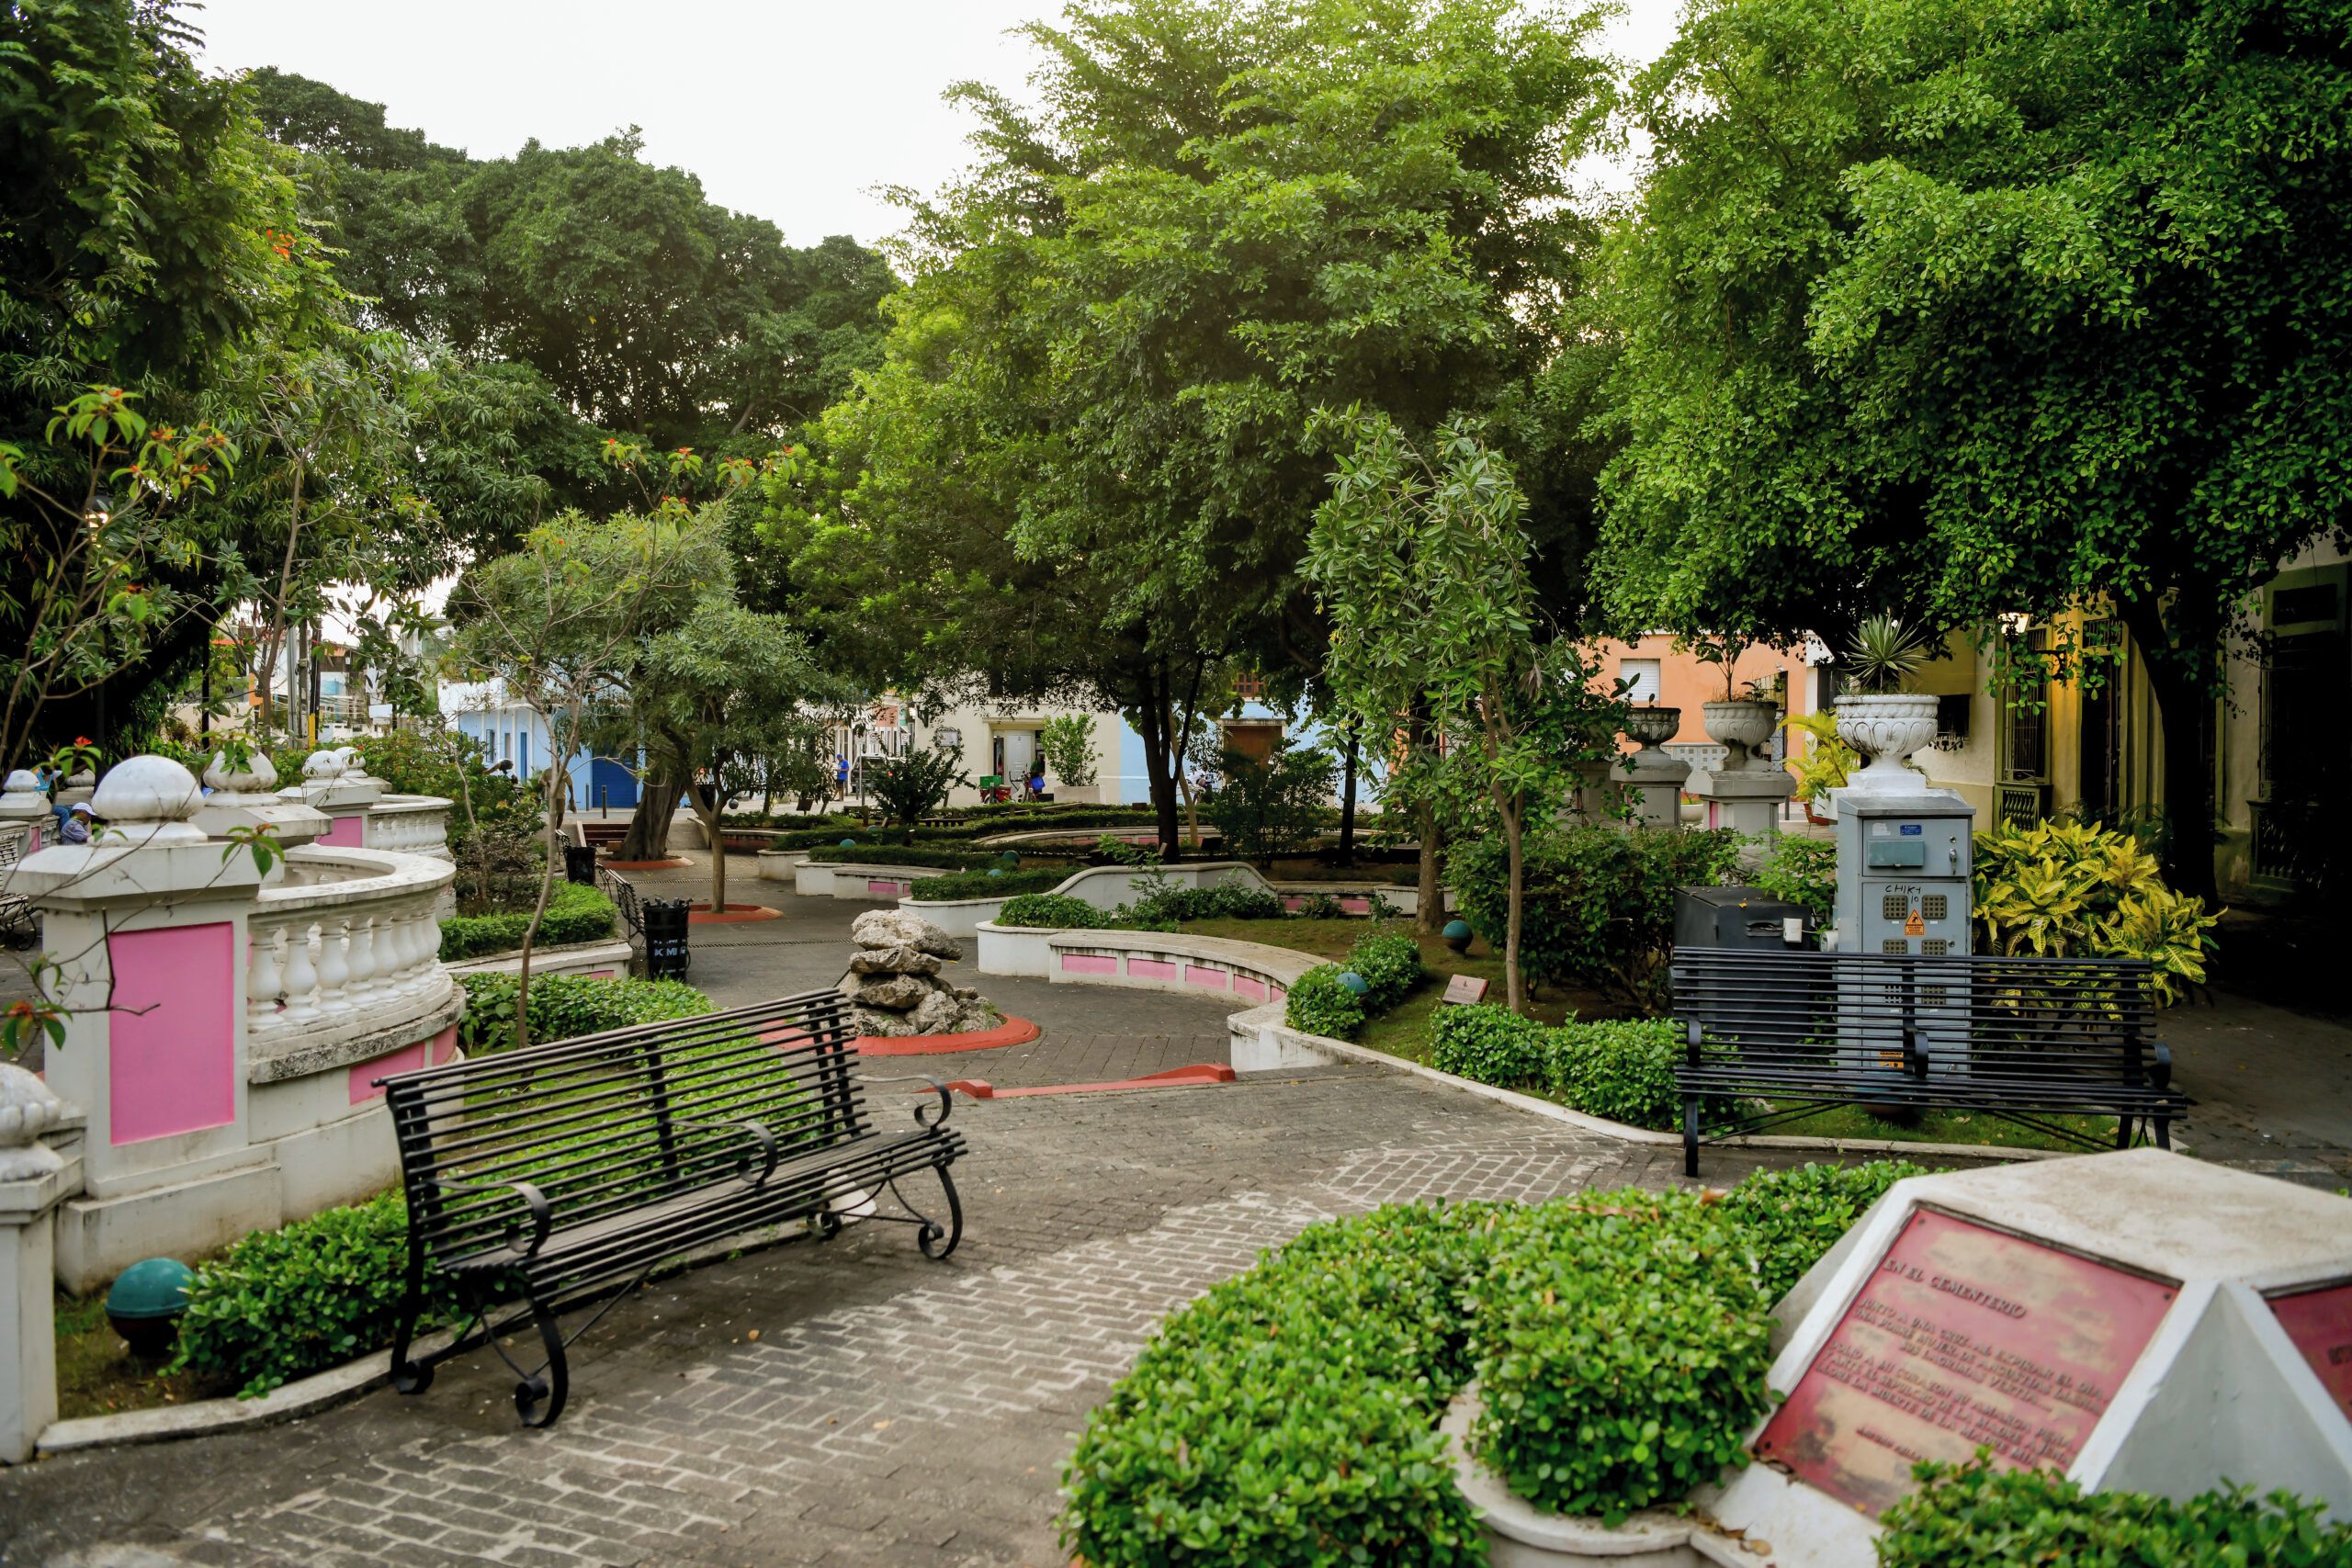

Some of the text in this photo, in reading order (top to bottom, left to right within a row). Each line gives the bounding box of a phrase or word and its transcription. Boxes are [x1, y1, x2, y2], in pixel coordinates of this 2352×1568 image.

[1881, 1258, 2030, 1320] EN EL CEMENTERIO
[1850, 1307, 1879, 1325] UNA
[1876, 1317, 1917, 1340] POBRE
[1958, 1349, 1978, 1364] DE
[1976, 1356, 2054, 1395] ANGUSTIAS
[1858, 1296, 1898, 1319] JUNTO
[1896, 1311, 1912, 1324] A
[1909, 1316, 1938, 1335] UNA
[1972, 1340, 1993, 1356] AL
[1994, 1348, 2057, 1381] EXPIRAR
[2054, 1371, 2077, 1389] EL
[1863, 1353, 1878, 1367] A
[1876, 1359, 1896, 1374] MI
[1951, 1391, 1972, 1407] SU
[1897, 1339, 1922, 1357] SUS
[1849, 1375, 1871, 1393] LA
[1869, 1384, 1919, 1414] MUERTE
[1917, 1405, 1939, 1423] DE
[1936, 1415, 1961, 1433] LA
[1958, 1424, 2011, 1456] MADRE
[1861, 1366, 1880, 1382] EL
[1878, 1373, 1939, 1407] SEPULCRO
[1934, 1398, 1955, 1415] DE
[1953, 1406, 1976, 1425] LA
[1973, 1416, 2025, 1446] MADRE
